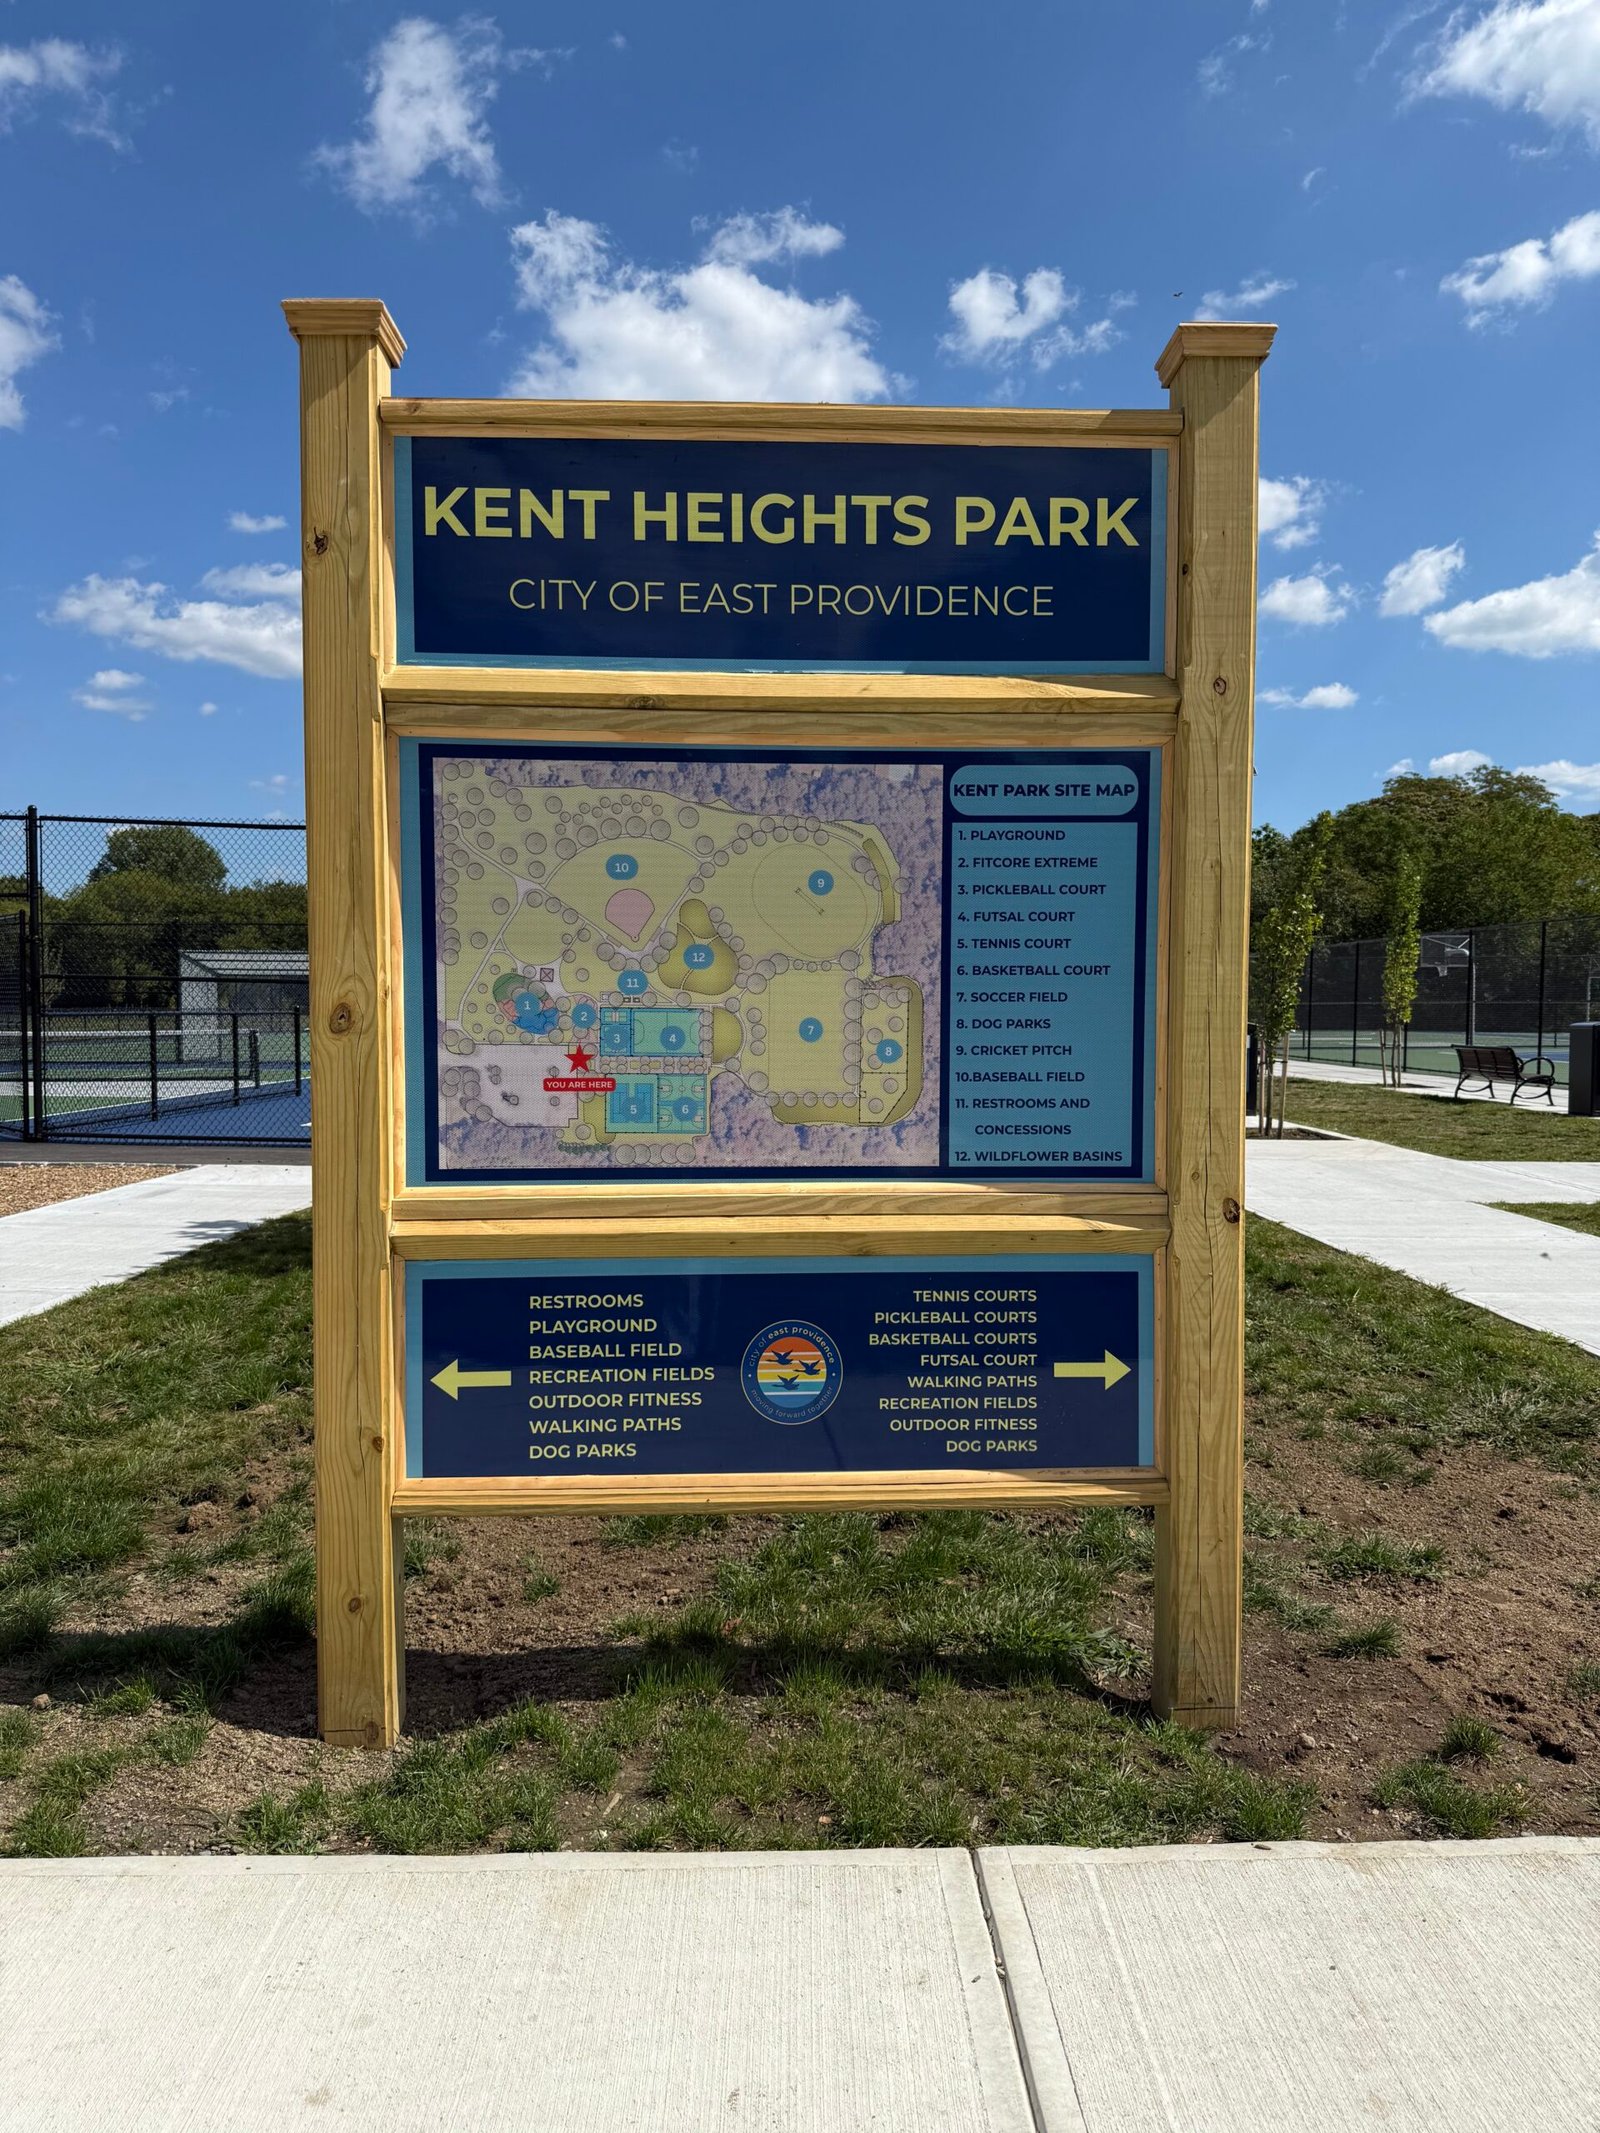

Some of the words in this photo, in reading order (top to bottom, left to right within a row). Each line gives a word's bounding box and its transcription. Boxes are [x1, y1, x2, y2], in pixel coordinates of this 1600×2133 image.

[424, 486, 610, 540] KENT
[634, 492, 930, 545] HEIGHTS
[956, 497, 1140, 546] PARK
[510, 579, 596, 610] CITY
[610, 581, 664, 611] OF
[680, 583, 777, 613] EAST
[791, 585, 1053, 615] PROVIDENCE
[954, 784, 999, 796] KENT
[1004, 784, 1050, 796] PARK
[1055, 784, 1091, 797] SITE
[1096, 784, 1135, 796] MAP
[958, 830, 966, 840] 1.
[971, 830, 1065, 840] PLAYGROUND
[958, 858, 969, 868] 2.
[973, 857, 1030, 868] FITCORE
[1035, 857, 1098, 868] EXTREME
[615, 863, 629, 873] 10
[817, 879, 825, 888] 9
[958, 885, 968, 895] 3.
[973, 885, 1055, 895] PICKLEBALL
[1059, 885, 1106, 895] COURT
[958, 912, 969, 922] 4.
[974, 912, 1024, 922] FUTSAL
[1028, 912, 1075, 922] COURT
[957, 939, 968, 949] 5.
[971, 938, 1021, 949] TENNIS
[1024, 939, 1071, 949] COURT
[692, 952, 705, 962] 12
[957, 965, 968, 975] 6.
[973, 965, 1060, 975] BASKETBALL
[1064, 965, 1111, 975] COURT
[626, 978, 638, 988] 11
[956, 992, 967, 1002] 7.
[971, 992, 1025, 1002] SOCCER
[1030, 992, 1068, 1002] FIELD
[524, 1001, 530, 1009] 1
[580, 1012, 587, 1021] 2
[956, 1019, 968, 1029] 8.
[972, 1019, 1002, 1029] DOG
[1007, 1019, 1051, 1029] PARKS
[807, 1026, 814, 1035] 7
[614, 1034, 620, 1043] 3
[668, 1034, 676, 1043] 4
[885, 1047, 892, 1056] 8
[956, 1045, 967, 1055] 9.
[971, 1045, 1028, 1055] CRICKET
[1032, 1045, 1072, 1055] PITCH
[1047, 1072, 1085, 1082] FIELD
[546, 1081, 567, 1089] YOU
[568, 1081, 586, 1089] ARE
[589, 1081, 613, 1089] HERE
[955, 1099, 968, 1109] 11.
[973, 1098, 1056, 1108] RESTROOMS
[1060, 1098, 1090, 1108] AND
[630, 1105, 637, 1114] 5
[681, 1105, 689, 1114] 6
[975, 1125, 1071, 1135] CONCESSIONS
[955, 1151, 970, 1161] 12.
[975, 1151, 1069, 1161] WILDFLOWER
[1073, 1151, 1123, 1161] BASINS
[913, 1291, 969, 1301] TENNIS
[974, 1290, 1036, 1301] COURTS
[530, 1294, 643, 1309] RESTROOMS
[875, 1312, 969, 1323] PICKLEBALL
[974, 1312, 1036, 1323] COURTS
[530, 1319, 657, 1333] PLAYGROUND
[870, 1334, 969, 1345] BASKETBALL
[975, 1333, 1036, 1344] COURTS
[530, 1344, 625, 1358] BASEBALL
[631, 1343, 681, 1356] FIELD
[749, 1348, 760, 1367] city
[759, 1337, 767, 1348] of
[768, 1326, 789, 1340] east
[792, 1326, 835, 1364] providence
[921, 1355, 979, 1366] FUTSAL
[984, 1355, 1037, 1365] COURT
[530, 1369, 646, 1384] RECREATION
[653, 1367, 714, 1381] FIELDS
[908, 1376, 981, 1387] WALKING
[987, 1376, 1037, 1387] PATHS
[529, 1394, 623, 1409] OUTDOOR
[629, 1392, 702, 1406] FITNESS
[880, 1398, 978, 1409] RECREATION
[984, 1397, 1037, 1408] FIELDS
[529, 1419, 616, 1434] WALKING
[623, 1417, 681, 1431] PATHS
[890, 1419, 969, 1431] OUTDOOR
[975, 1419, 1037, 1430] FITNESS
[530, 1445, 570, 1459] DOG
[577, 1443, 636, 1457] PARKS
[947, 1440, 981, 1452] DOG
[987, 1440, 1037, 1451] PARKS
